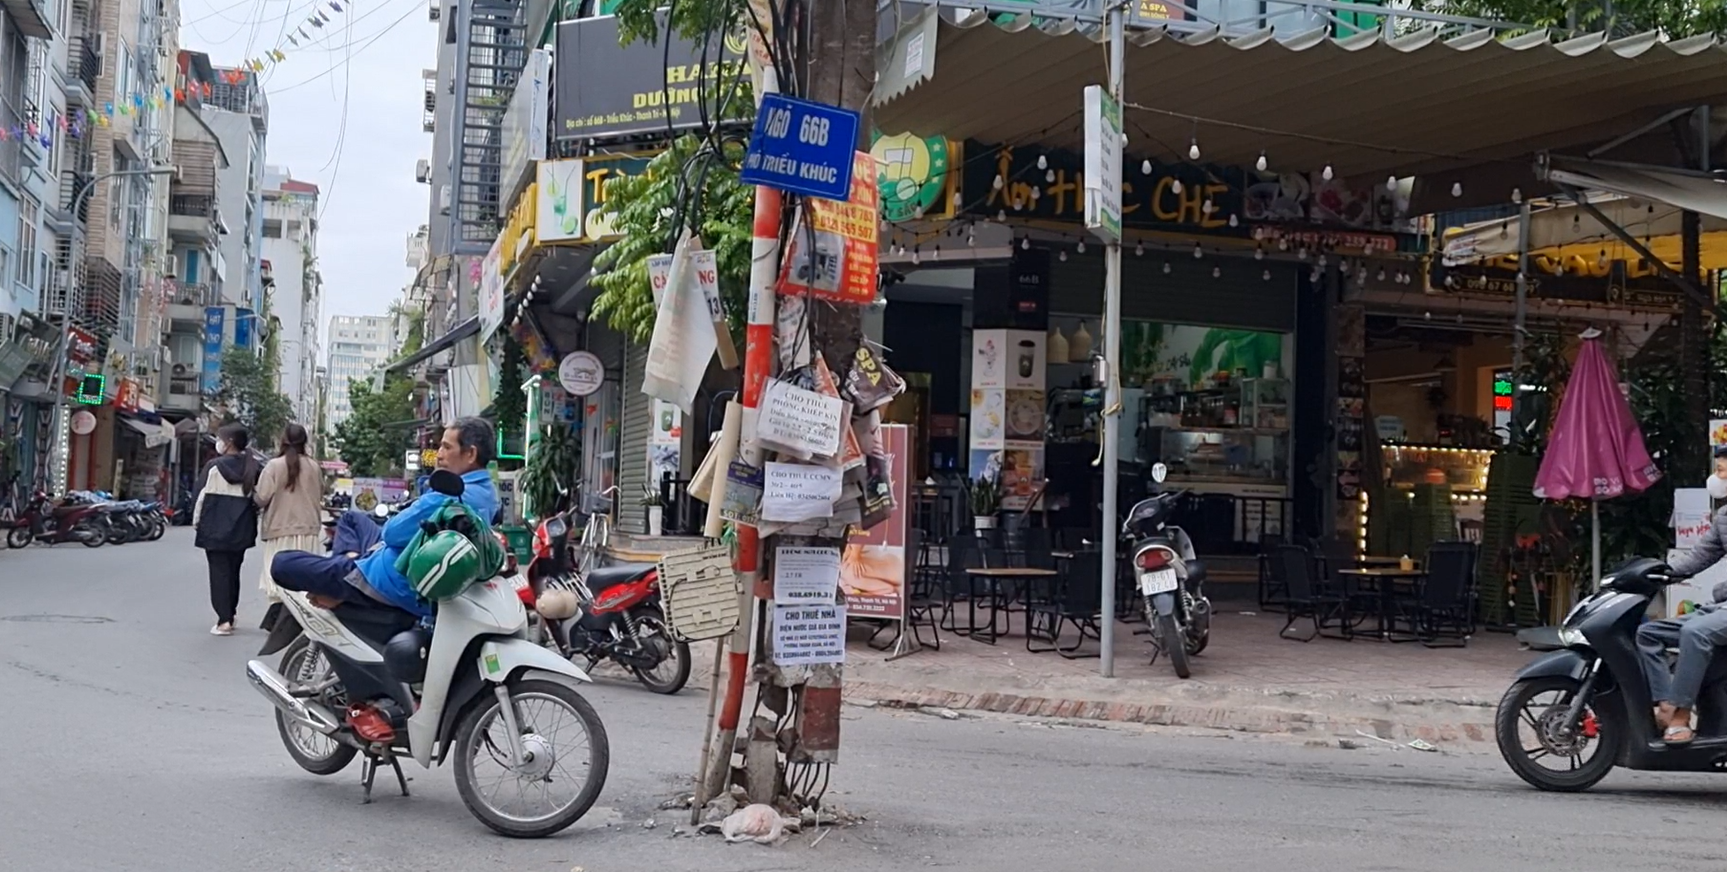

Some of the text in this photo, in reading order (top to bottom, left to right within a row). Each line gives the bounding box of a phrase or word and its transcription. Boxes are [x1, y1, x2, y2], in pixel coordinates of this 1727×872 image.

[1149, 3, 1167, 12] SPA
[799, 114, 830, 146] 66B
[800, 162, 838, 184] KHÚC
[1019, 274, 1040, 284] 66B
[1488, 281, 1501, 291] 67
[856, 347, 882, 387] SPA
[784, 392, 804, 402] CHO
[770, 470, 787, 479] CHO
[785, 611, 800, 620] CHO
[802, 609, 819, 620] THUÊ
